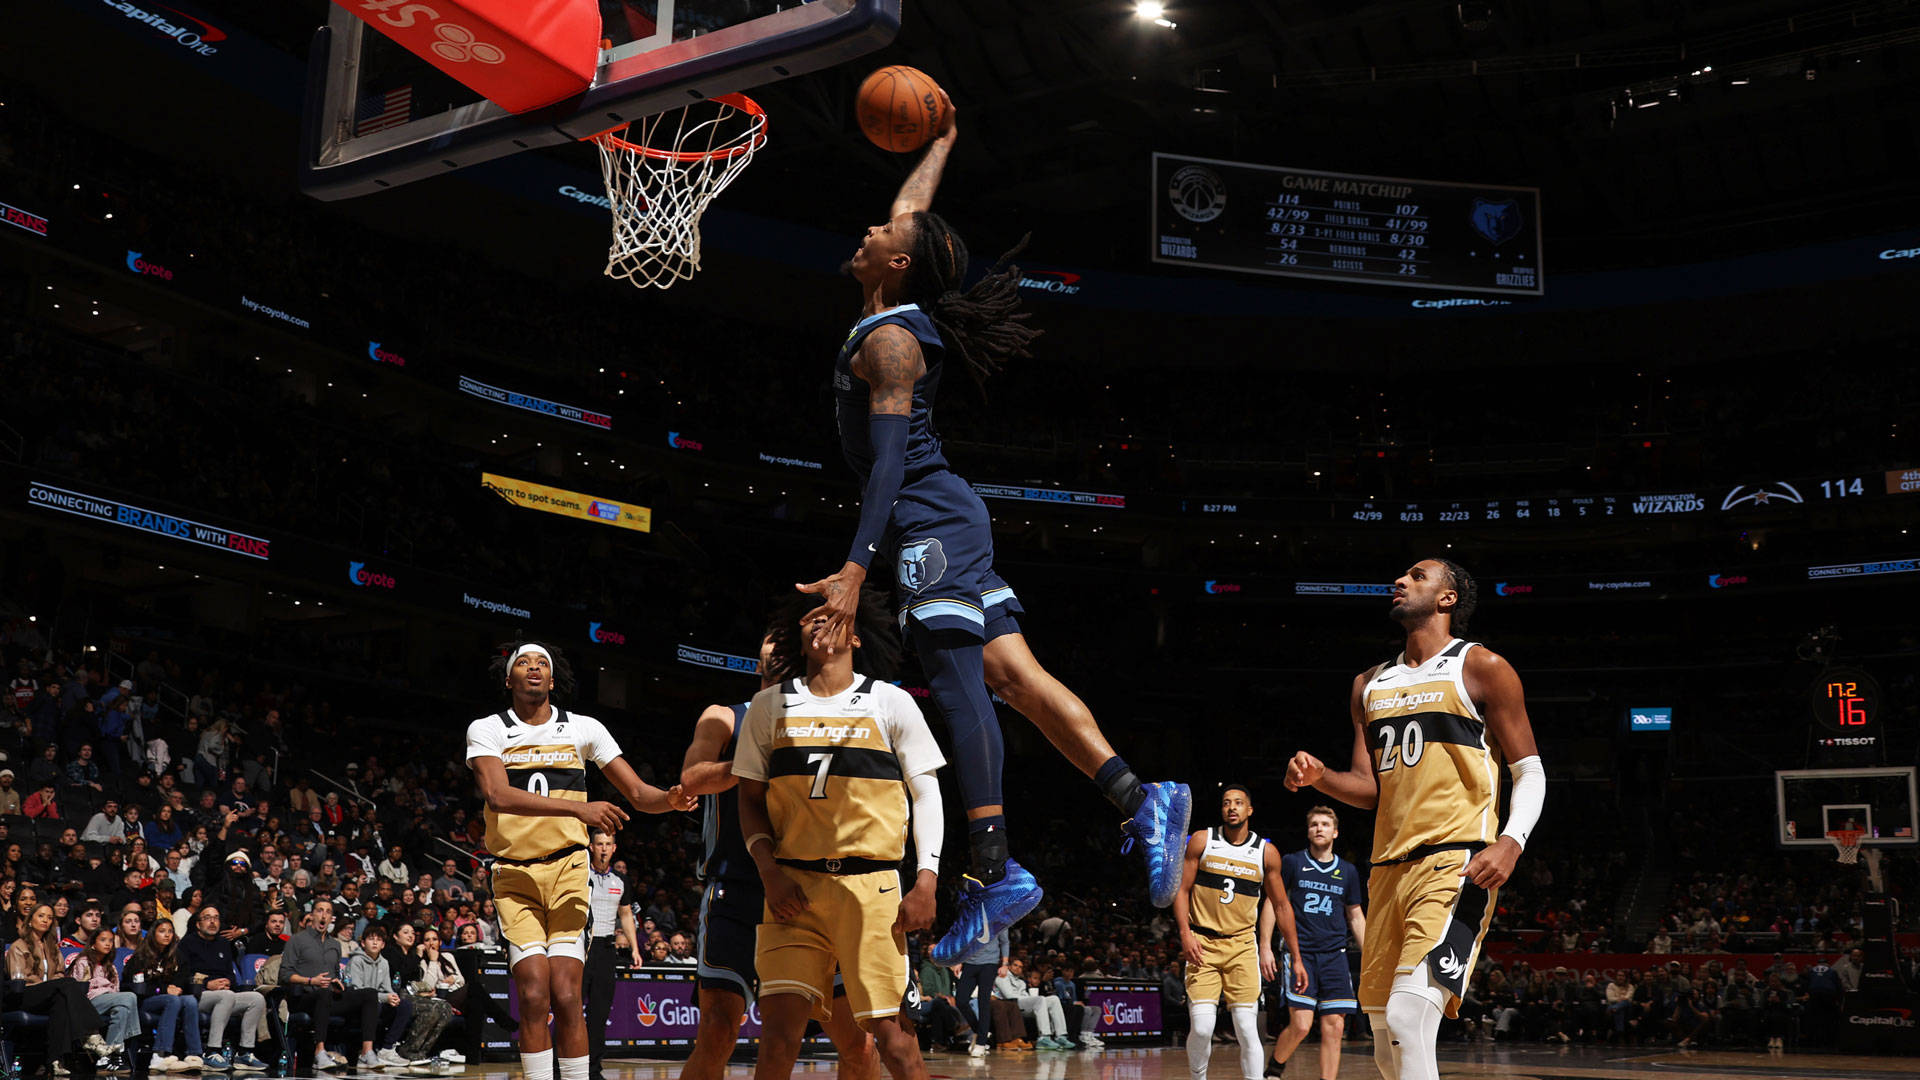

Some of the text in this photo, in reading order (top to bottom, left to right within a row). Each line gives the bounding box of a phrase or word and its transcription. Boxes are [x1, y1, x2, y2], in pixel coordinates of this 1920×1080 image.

[1282, 175, 1413, 200] GAME MATCHUP
[1278, 193, 1301, 206] 114
[1395, 203, 1420, 216] 107
[7, 208, 48, 234] FANS
[1266, 207, 1310, 221] 42/99
[1385, 219, 1428, 232] 41/99
[1270, 222, 1305, 237] 8/33
[1389, 233, 1425, 246] 8/30
[1160, 244, 1198, 260] WIZARDS
[1280, 238, 1299, 250] 54
[1398, 249, 1417, 261] 42
[1280, 253, 1298, 265] 26
[1399, 263, 1417, 275] 25
[1019, 278, 1080, 295] italOne
[241, 295, 310, 328] hey-coyote.com
[458, 379, 506, 400] CONNECTING
[507, 392, 558, 415] BRANDS
[560, 407, 582, 420] WITH
[759, 452, 823, 471] hey-coyote.com
[516, 490, 526, 499] to
[528, 492, 549, 504] spot
[1023, 489, 1072, 502] BRANDS
[1073, 494, 1096, 503] WITH
[1639, 493, 1697, 503] WASHINGTON
[1820, 478, 1865, 499] 114
[1202, 504, 1238, 513] 8:27 PM
[1352, 505, 1614, 522] 42/99 8/33 22/23 26 64 18 5 2
[1632, 498, 1705, 515] WIZARDS
[28, 487, 271, 558] CONNECTING BRANDS WITH FANS
[1807, 561, 1916, 576] CONNECTING BRANDS
[1343, 585, 1387, 593] BRANDS
[463, 592, 532, 620] hey-coyote.com
[677, 648, 725, 667] CONNECTING
[1827, 682, 1857, 698] 17.2
[1367, 690, 1445, 713] washington
[1839, 697, 1867, 726] 16
[776, 720, 871, 743] washington
[1833, 737, 1876, 746] TISSOT
[502, 748, 573, 766] washington
[1377, 719, 1425, 773] 20
[806, 752, 834, 800] 7
[1205, 860, 1257, 877] washington
[1219, 877, 1237, 905] 3
[1298, 879, 1345, 896] GRIZZLIES
[1303, 892, 1335, 916] 24
[659, 998, 700, 1027] Gian
[1115, 1002, 1144, 1025] Giant
